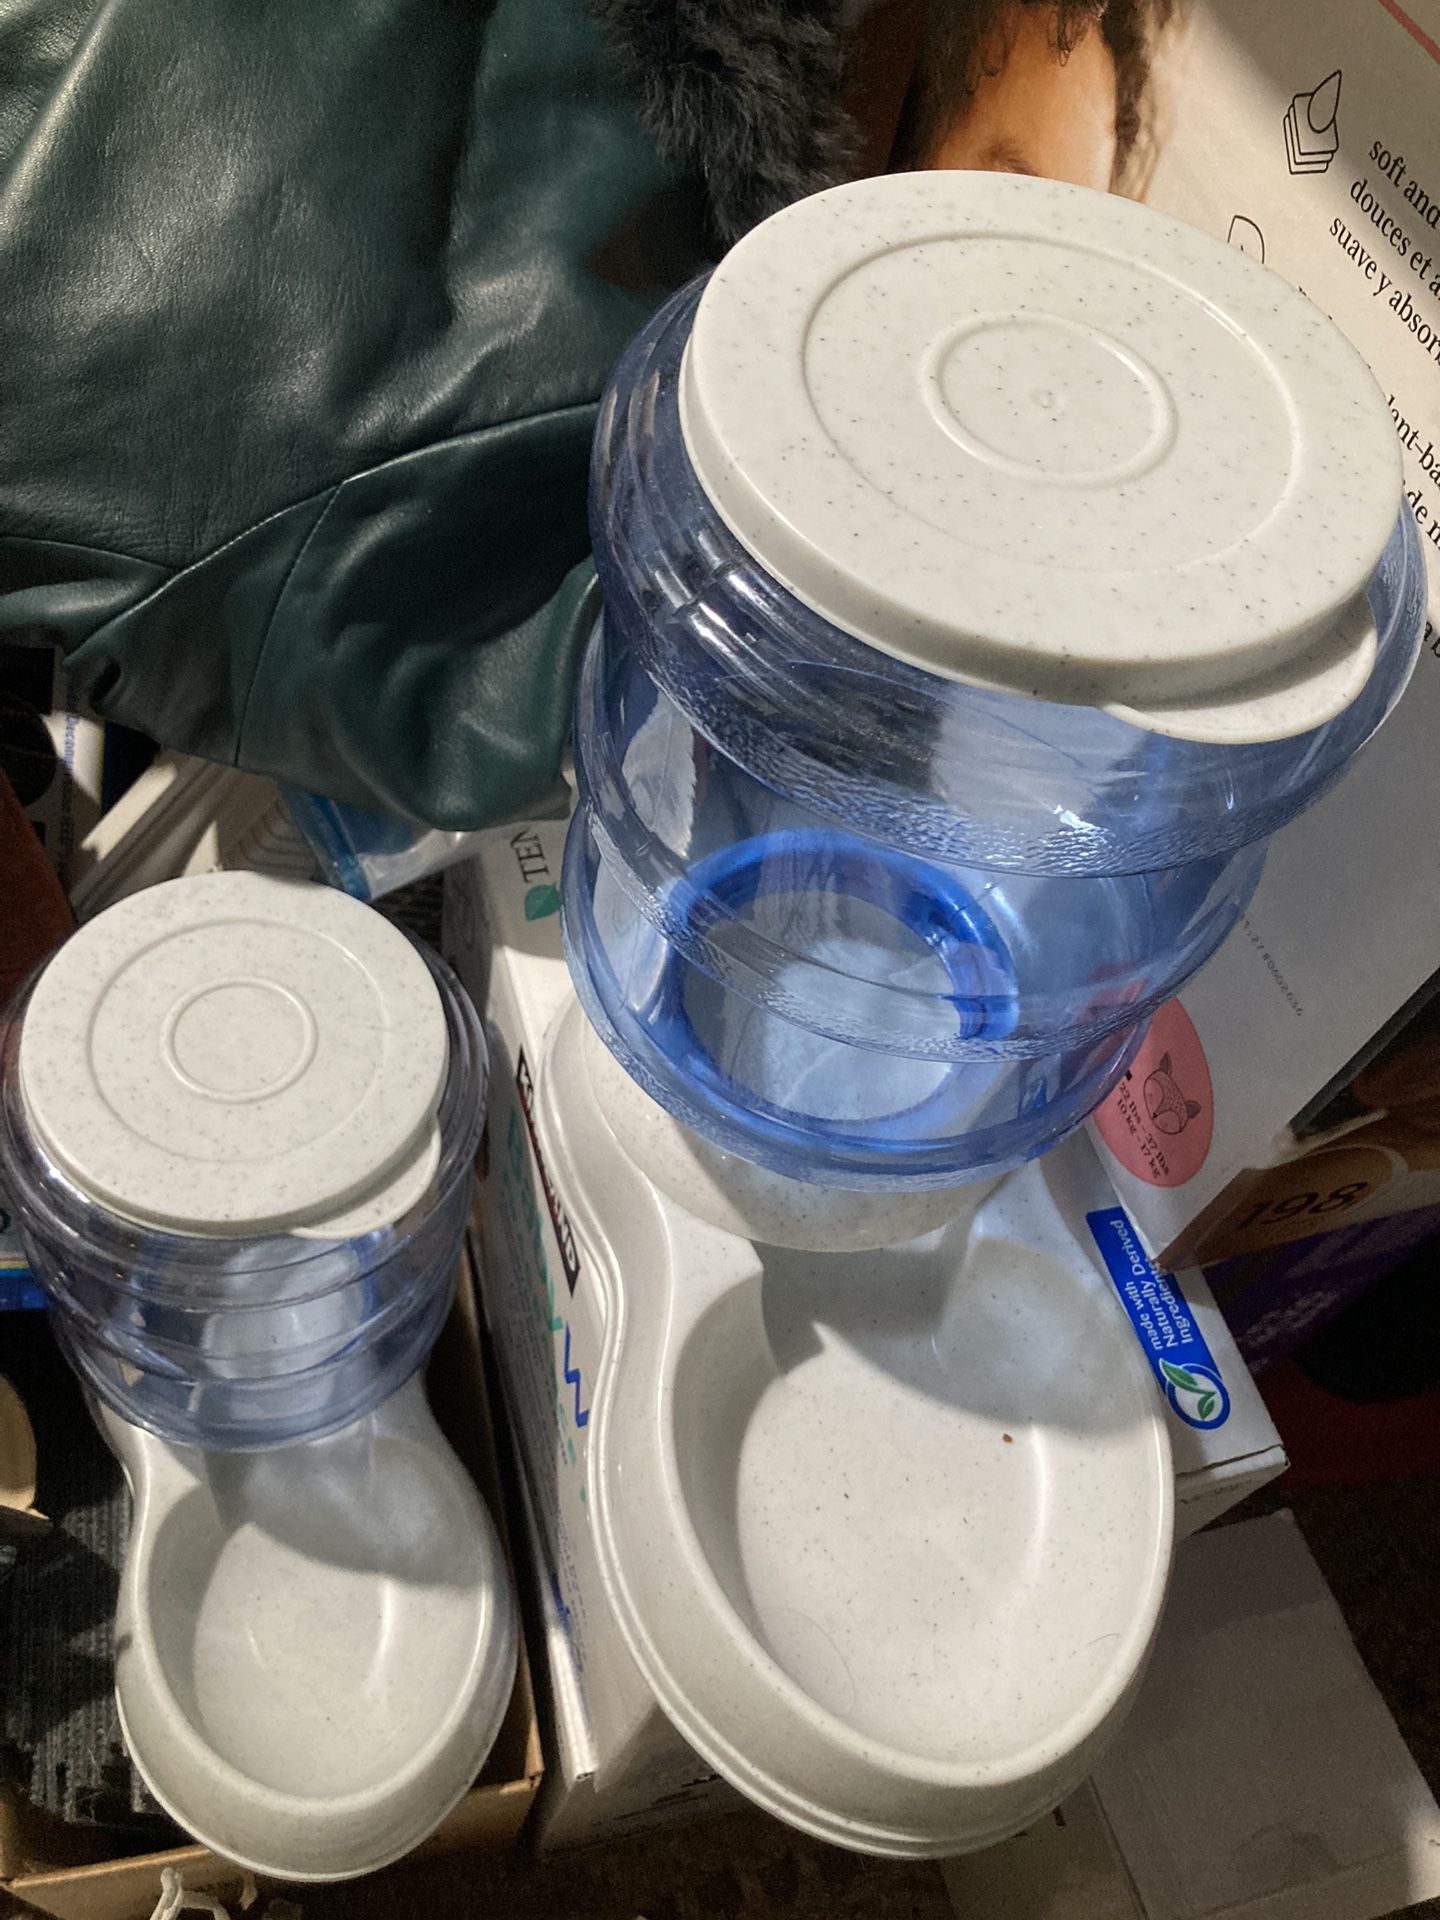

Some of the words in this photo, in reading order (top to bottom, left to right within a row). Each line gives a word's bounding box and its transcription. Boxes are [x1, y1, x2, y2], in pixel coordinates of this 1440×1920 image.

[1369, 140, 1407, 188] soft
[1350, 178, 1411, 257] douces
[1410, 251, 1433, 280] et
[1329, 217, 1377, 280] suave
[1372, 271, 1393, 297] y
[1388, 290, 1440, 366] absor
[1126, 1114, 1138, 1136] kg
[1140, 1143, 1152, 1157] 17
[1148, 1157, 1161, 1179] kg
[1147, 1132, 1159, 1151] 37
[1155, 1151, 1170, 1176] lbs
[1109, 1219, 1147, 1277] Derived
[1124, 1280, 1145, 1311] with
[1140, 1279, 1179, 1348] Naturally
[1140, 1312, 1164, 1351] made
